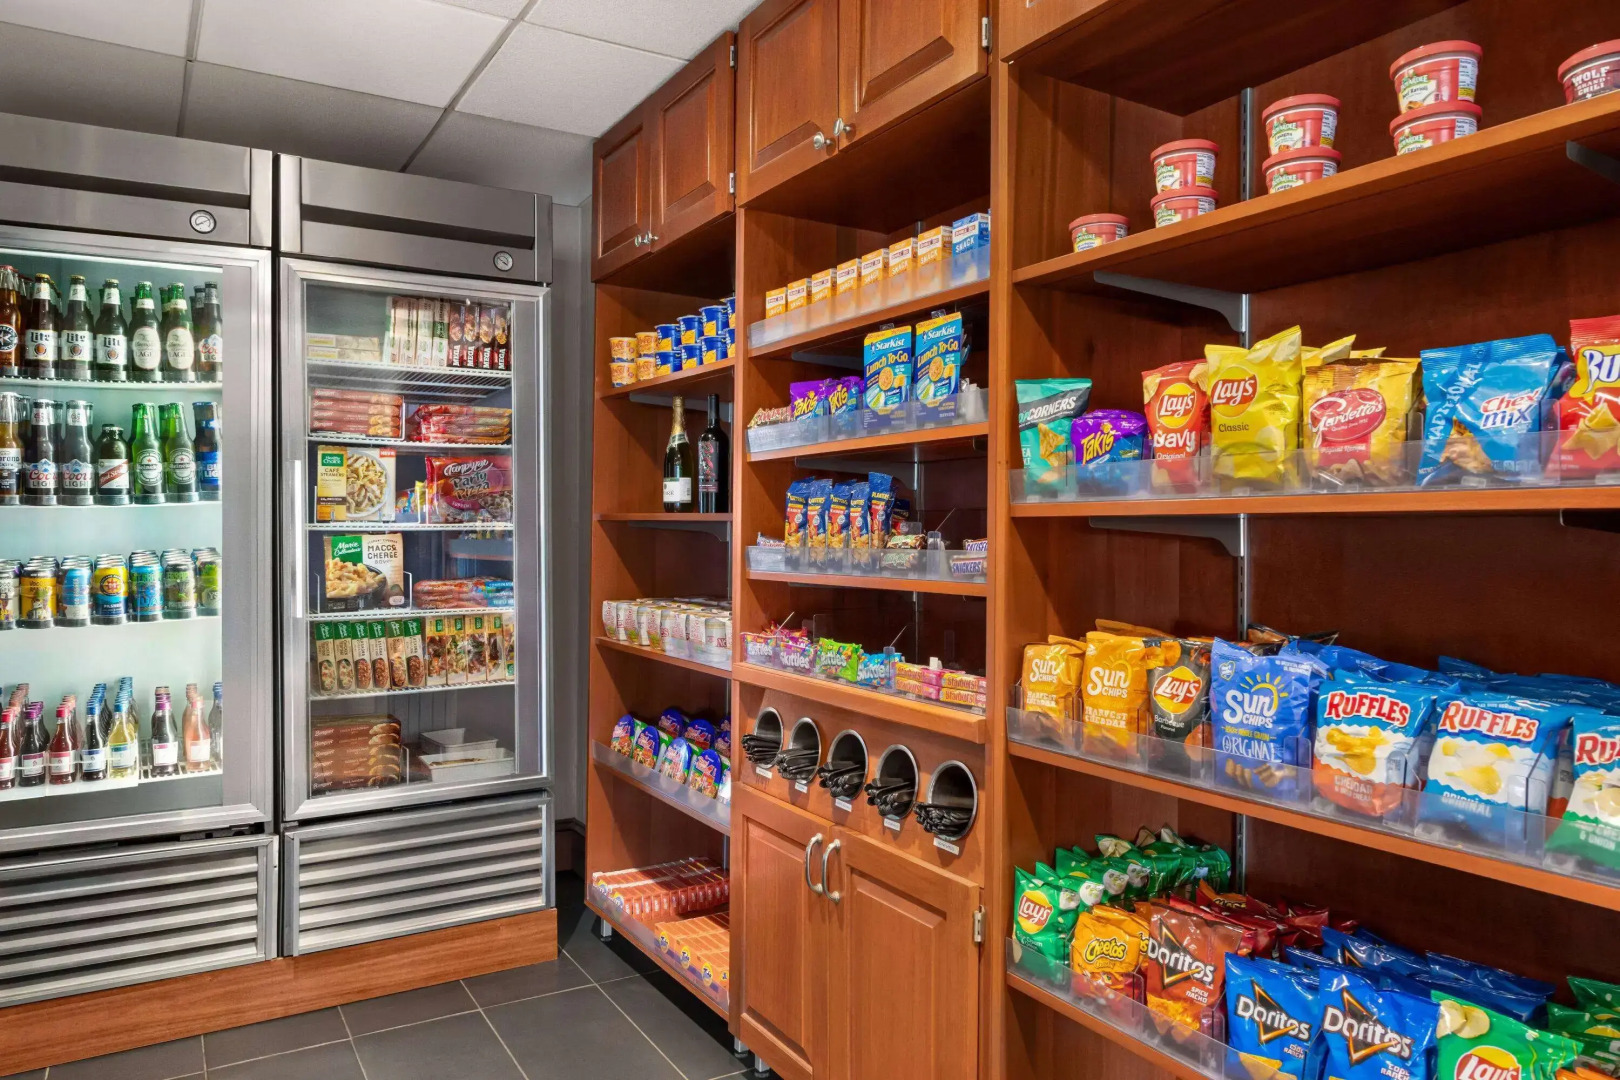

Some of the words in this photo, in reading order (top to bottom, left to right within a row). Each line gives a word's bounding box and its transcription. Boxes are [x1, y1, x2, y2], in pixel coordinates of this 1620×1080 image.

[1572, 66, 1610, 87] WOLF
[1578, 83, 1605, 96] CHILI
[955, 236, 975, 253] SNACK
[920, 248, 938, 265] SNACK
[875, 337, 905, 351] StarKist
[928, 325, 957, 340] StarKist
[452, 345, 462, 367] MEGA
[467, 345, 476, 367] MEGA
[483, 347, 492, 369] MEGA
[498, 348, 507, 370] MEGA
[866, 355, 887, 377] Lunch
[917, 344, 938, 368] Lunch
[1581, 348, 1620, 394] BU
[1212, 377, 1256, 407] Lay's
[1481, 387, 1543, 414] Chex
[1160, 393, 1195, 418] Lay's
[1218, 422, 1250, 433] Classic
[1308, 396, 1384, 449] Gardetto's
[1022, 448, 1032, 457] EA
[1081, 430, 1115, 467] Takis
[1157, 452, 1186, 462] Original
[952, 561, 982, 574] SNICKERS
[1029, 658, 1060, 683] Sun
[1038, 674, 1057, 683] CHIPS
[1086, 666, 1130, 696] Sun
[1101, 686, 1128, 699] CHIPS
[1155, 676, 1200, 704] Lay's
[1085, 706, 1128, 721] HARVEST
[1222, 689, 1279, 725] Sun
[1324, 690, 1411, 728] RUFFLES
[1085, 714, 1127, 729] CHEDDAR
[1154, 714, 1185, 729] Barbecue
[1242, 713, 1273, 729] CHIPS
[1438, 700, 1540, 742] RUFFLES
[1222, 735, 1283, 763] ORIGINAL
[1575, 732, 1620, 765] RU
[1441, 791, 1492, 818] ORIGINAL
[1018, 896, 1052, 925] Lay's
[1084, 937, 1128, 964] Cheetos
[1147, 937, 1215, 983] Doritos
[1190, 986, 1209, 997] SPICY
[1236, 995, 1311, 1040] Doritos
[1323, 1006, 1414, 1059] Doritos
[1458, 1055, 1518, 1080] Lay's
